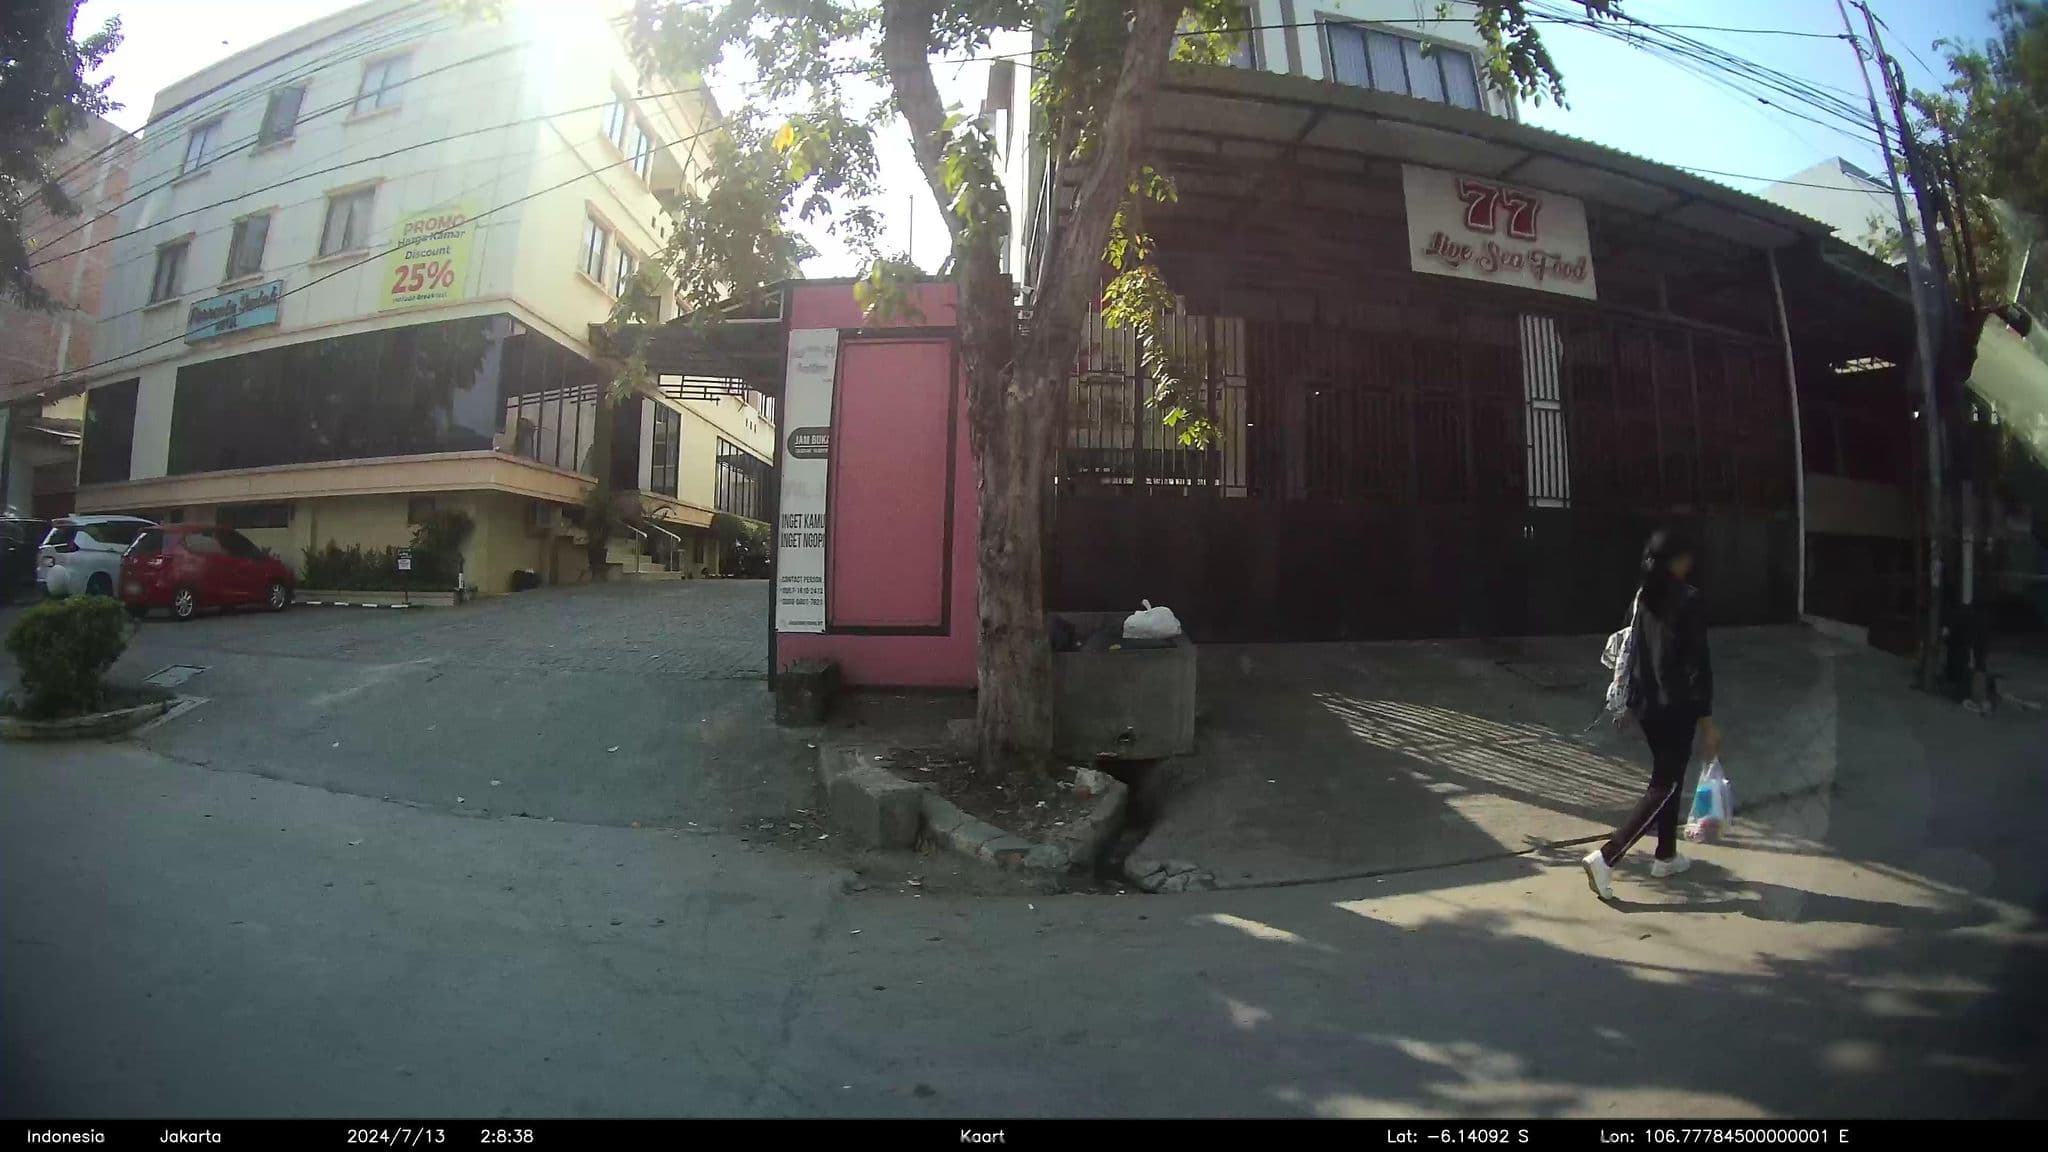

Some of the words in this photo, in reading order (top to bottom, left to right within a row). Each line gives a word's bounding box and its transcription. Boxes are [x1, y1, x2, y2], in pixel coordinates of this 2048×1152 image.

[1456, 177, 1541, 241] 77
[402, 213, 466, 236] PROMO
[429, 230, 466, 241] Kamar
[404, 245, 452, 260] Discount
[1424, 231, 1473, 269] Live
[1475, 240, 1525, 273] Sea
[1527, 250, 1588, 281] Food
[391, 259, 455, 295] 25%
[794, 435, 811, 445] JAM
[781, 513, 803, 529] INGET
[780, 533, 802, 548] INGET
[781, 575, 803, 584] CONTACT
